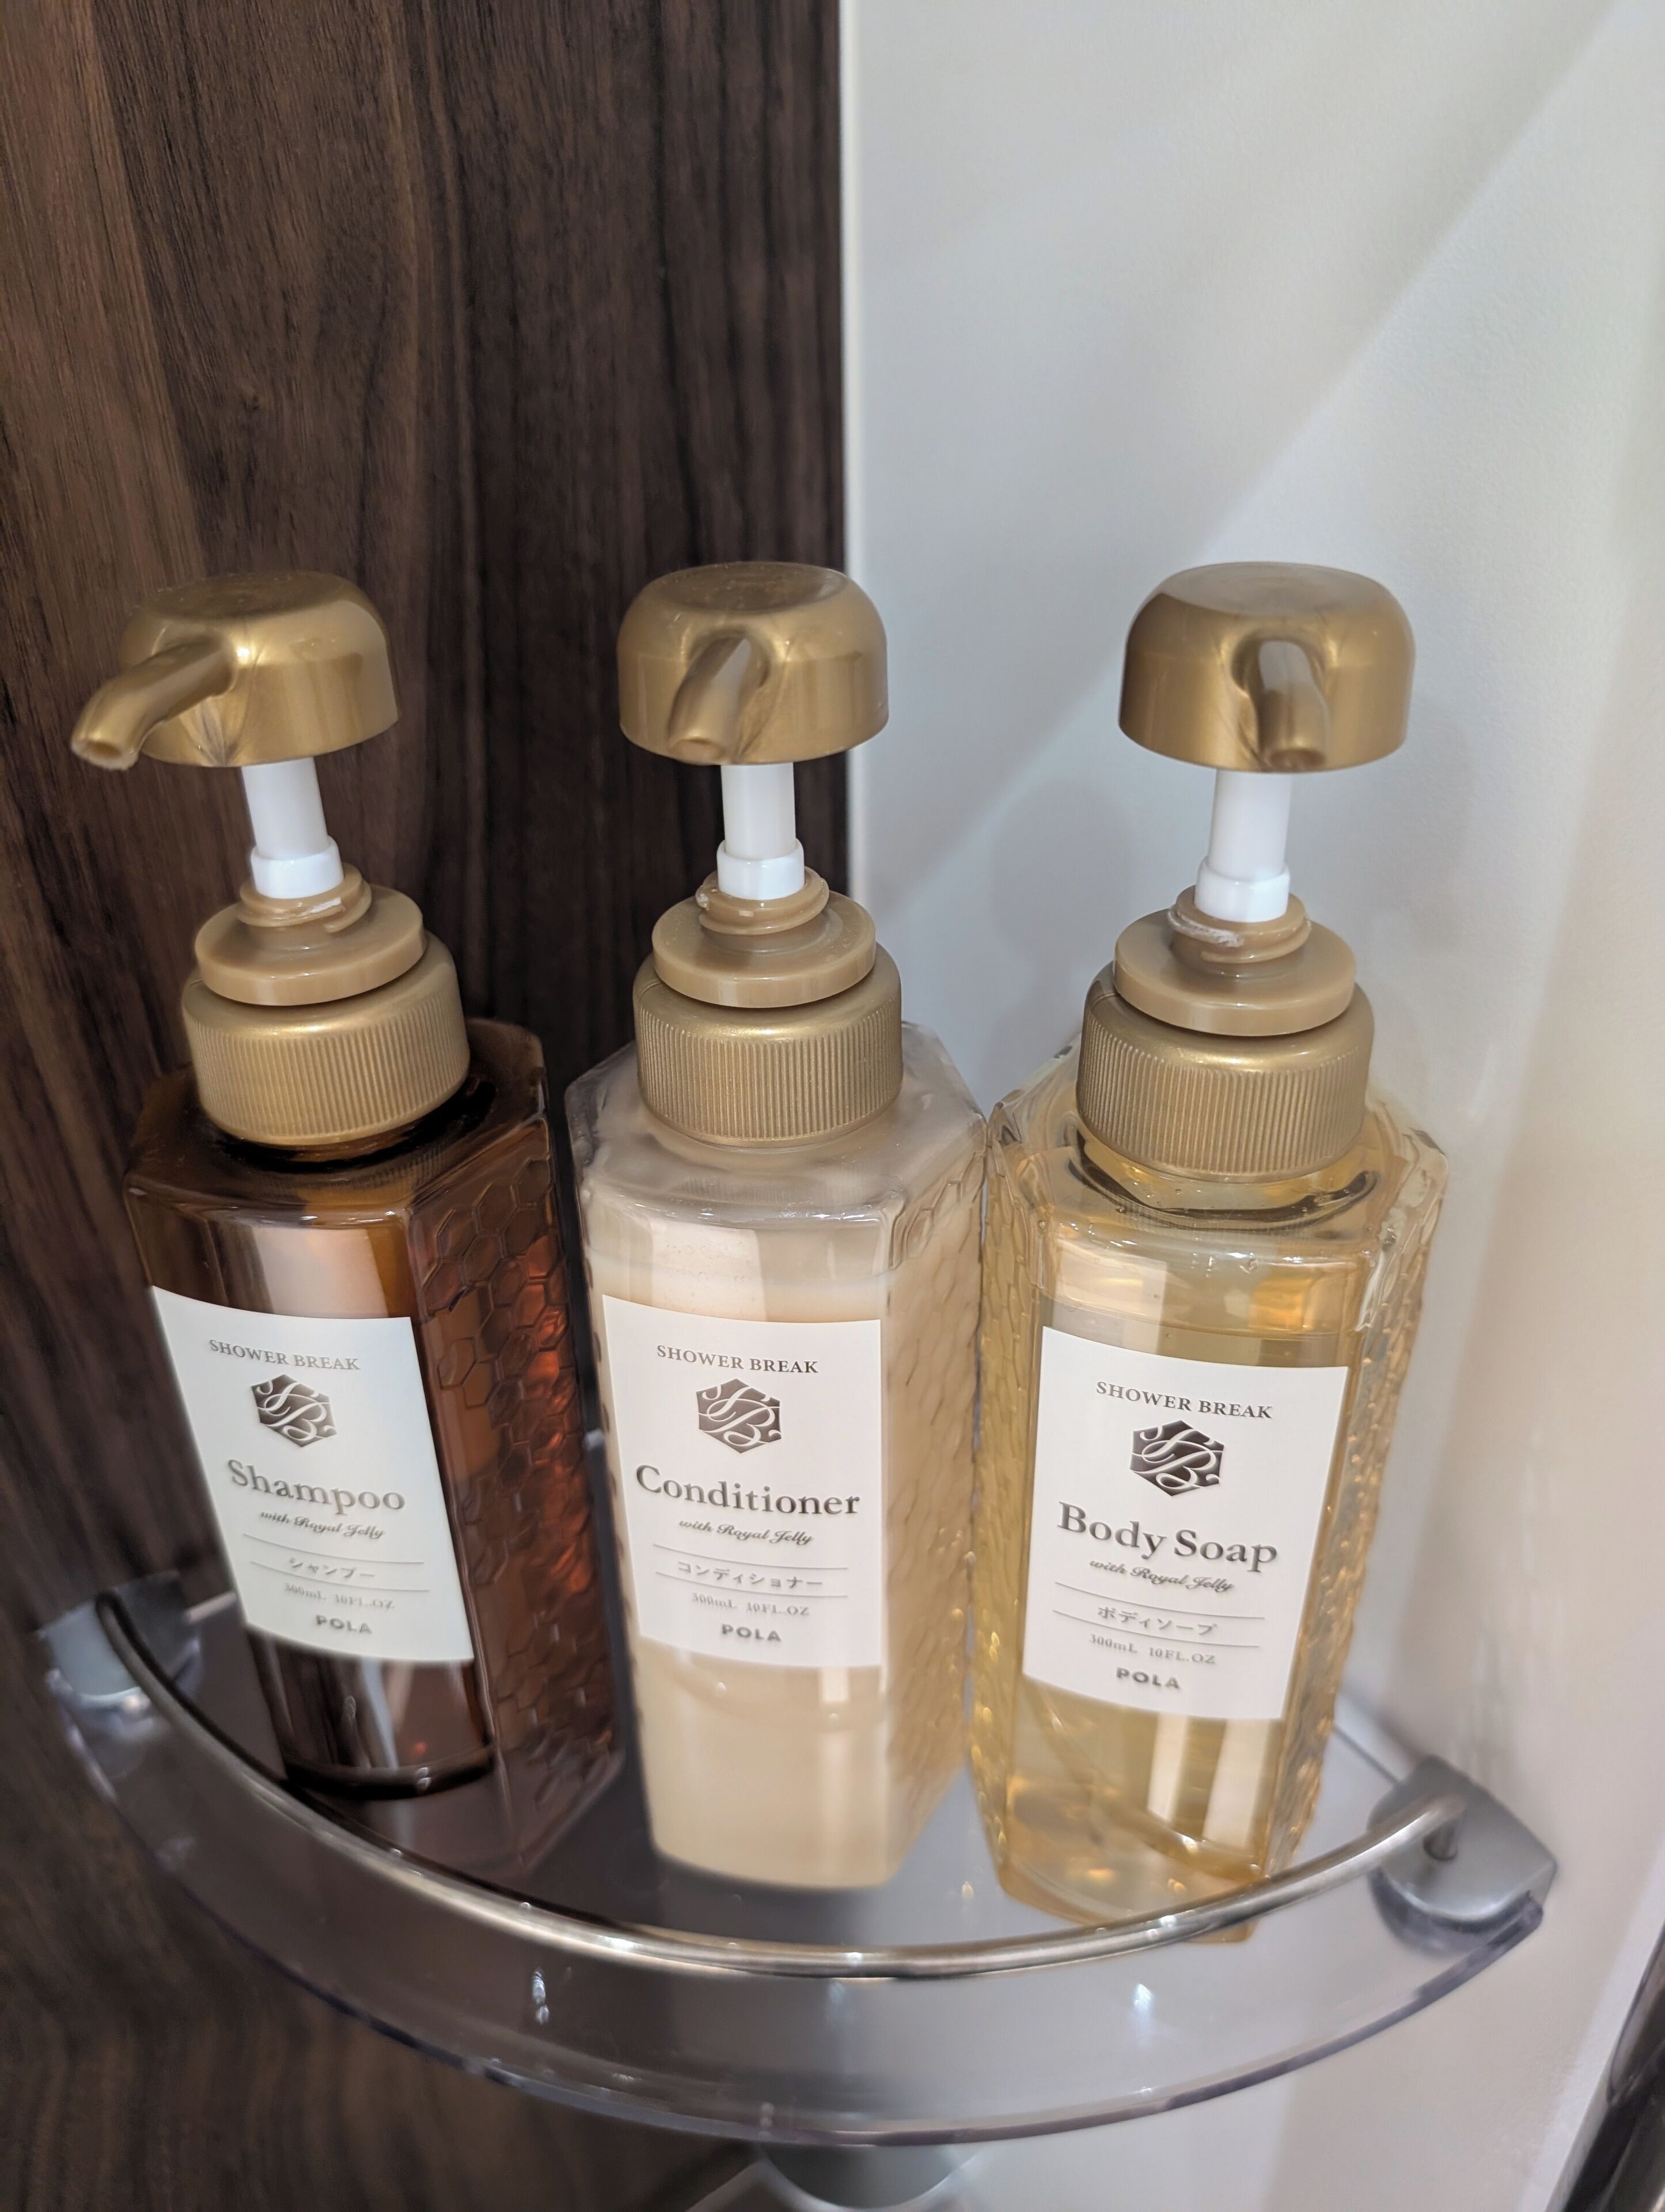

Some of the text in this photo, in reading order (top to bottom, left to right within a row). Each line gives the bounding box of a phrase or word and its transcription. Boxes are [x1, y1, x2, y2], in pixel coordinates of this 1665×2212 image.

[210, 1339, 361, 1370] SHOWER BREAK
[657, 1344, 818, 1373] SHOWER BREAK
[1096, 1381, 1272, 1419] SHOWER BREAK
[227, 1459, 405, 1514] Shampoo
[636, 1464, 860, 1515] Conditioner
[260, 1511, 386, 1539] with Royal Jelly
[679, 1519, 813, 1546] with Royal Jelly
[1057, 1501, 1278, 1572] Body Soap
[677, 1561, 823, 1588] コンディショナー
[1090, 1559, 1235, 1593] with Royal Jelly
[692, 1592, 737, 1609] 300mL
[316, 1615, 372, 1634] POLA
[722, 1623, 782, 1642] POLA
[1098, 1607, 1218, 1635] ボディソープ
[1088, 1633, 1137, 1653] 300mL
[1116, 1667, 1180, 1688] POLA
